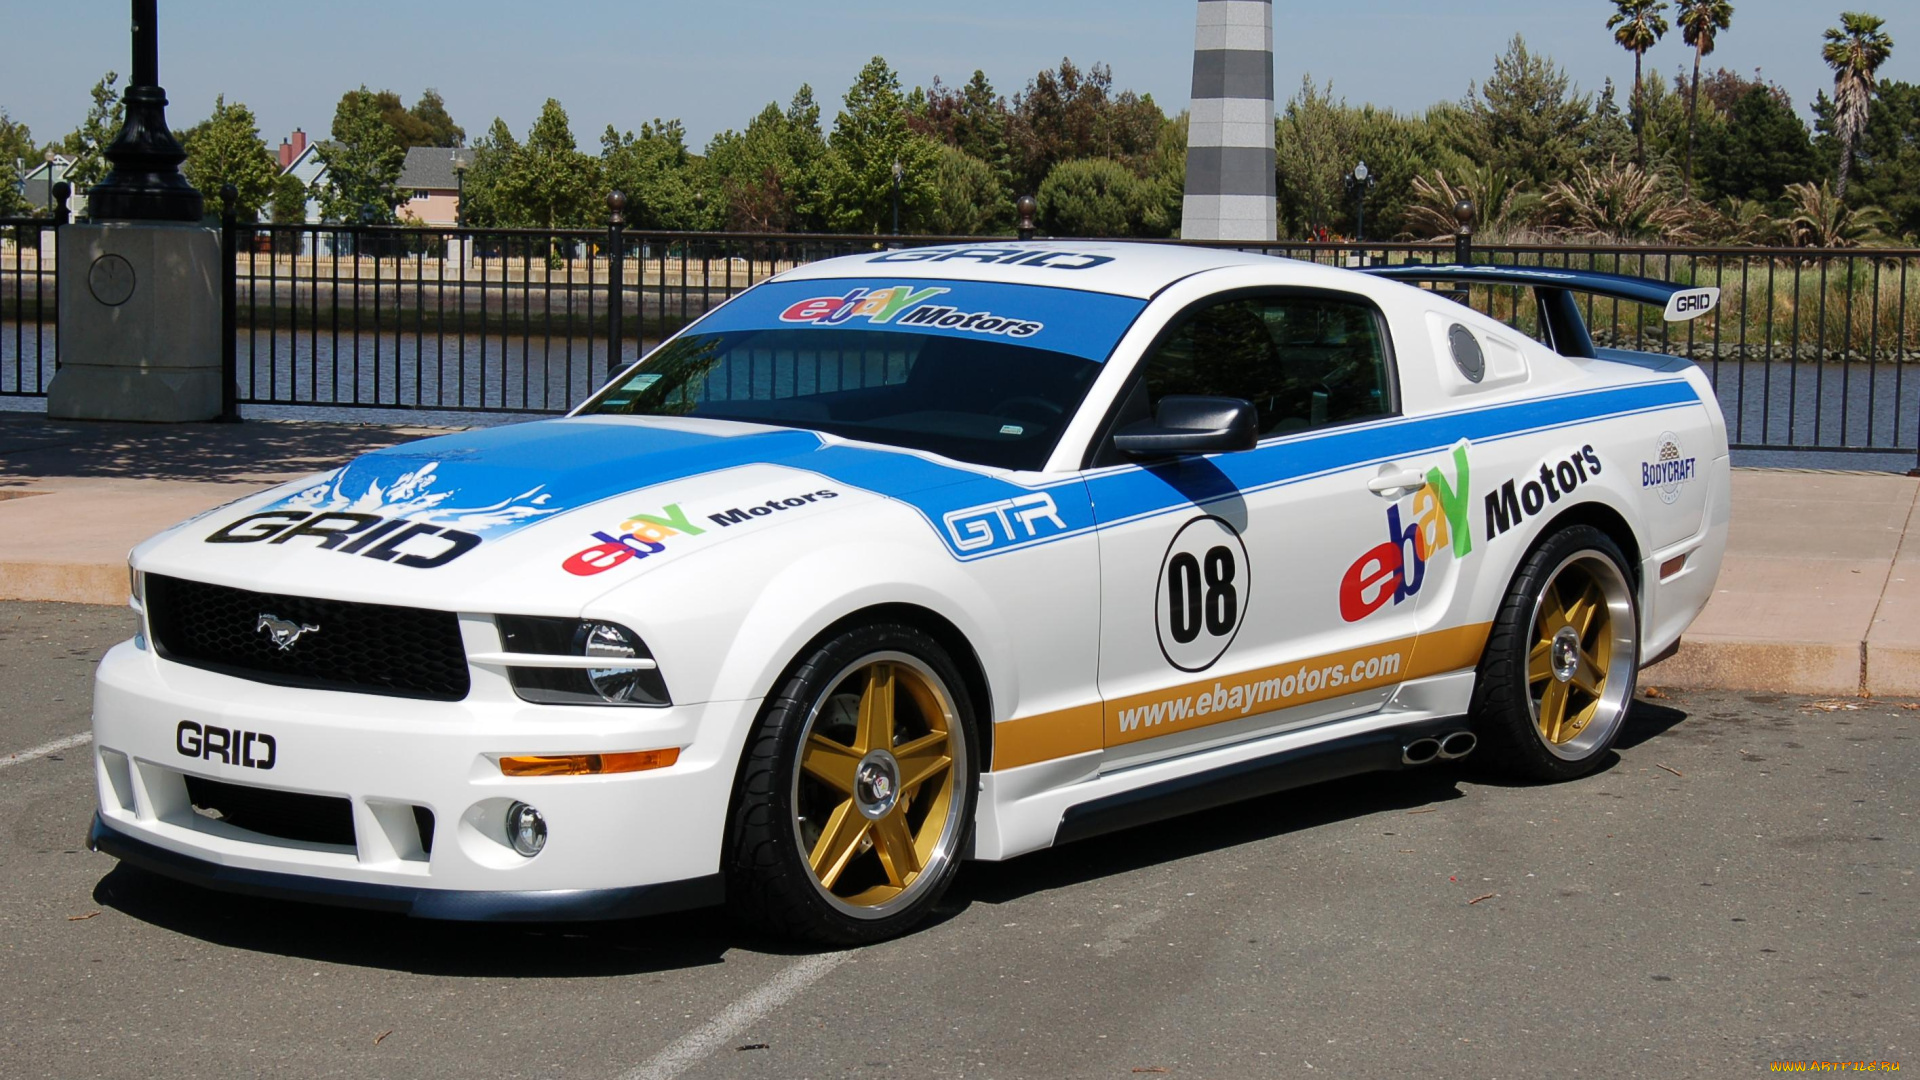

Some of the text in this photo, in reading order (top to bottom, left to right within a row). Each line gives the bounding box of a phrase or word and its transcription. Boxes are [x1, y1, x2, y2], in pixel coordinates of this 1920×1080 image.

[866, 250, 1116, 270] GRID
[901, 306, 1041, 337] Motors
[1676, 293, 1710, 312] GRID
[1484, 444, 1602, 542] Motors
[1642, 457, 1696, 487] BODYCRAFT
[707, 489, 839, 528] Motors
[942, 491, 1068, 551] GTR
[204, 510, 483, 569] GRID
[1168, 545, 1238, 644] 08
[1118, 652, 1400, 733] www.ebaymotors.com
[176, 719, 277, 770] GRID
